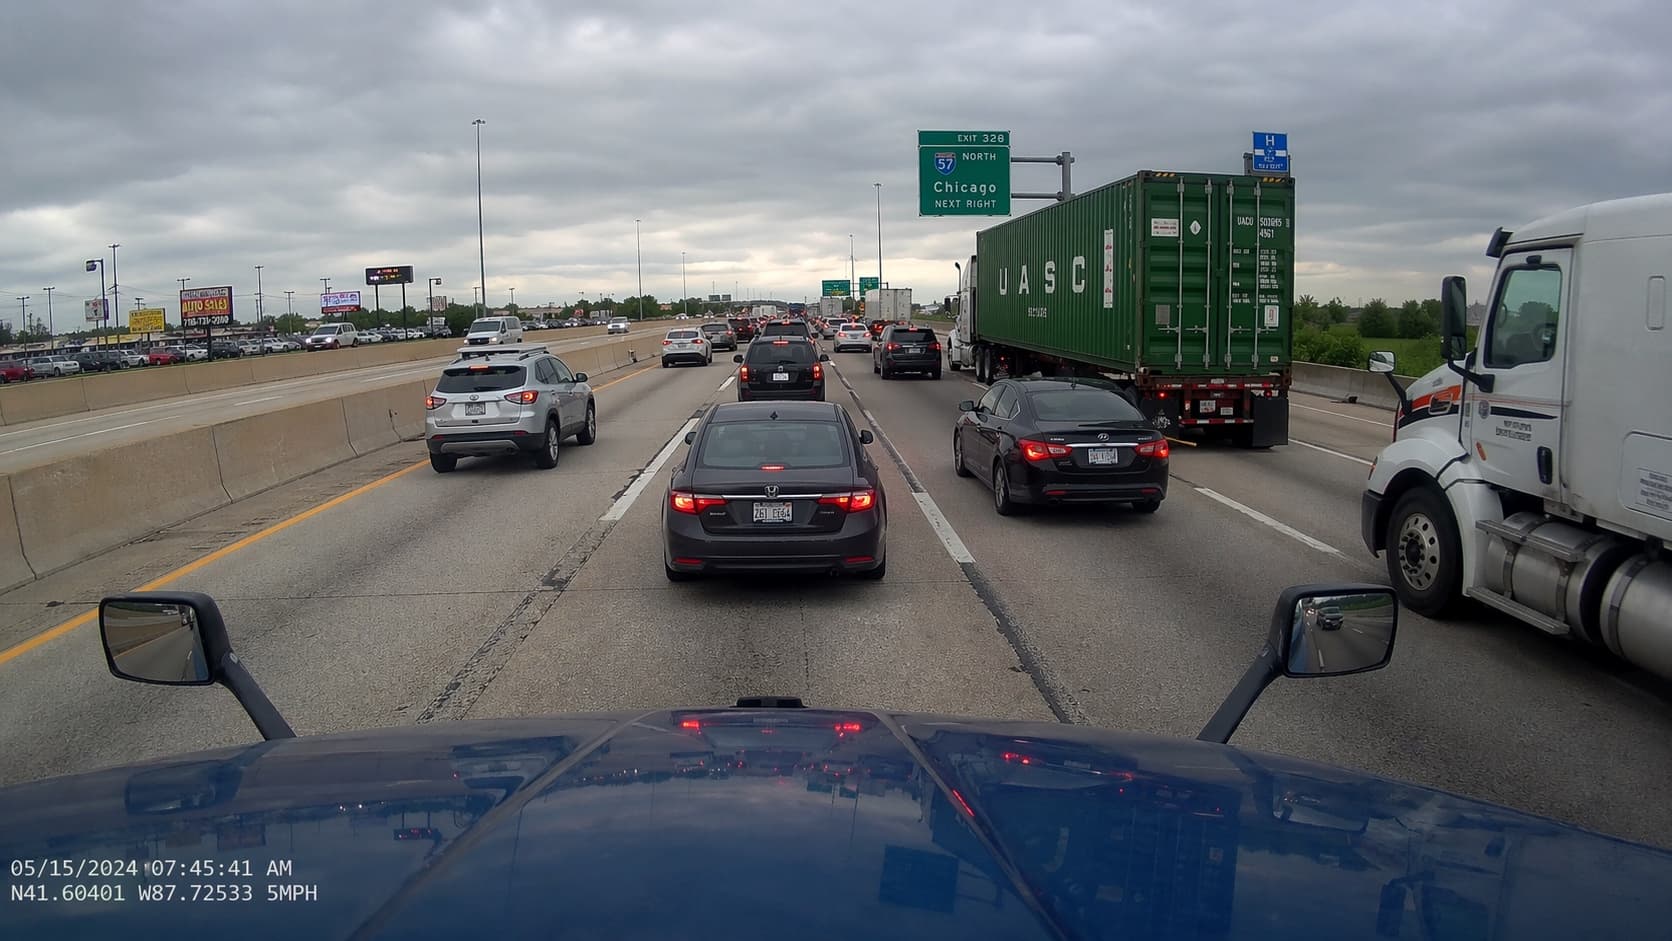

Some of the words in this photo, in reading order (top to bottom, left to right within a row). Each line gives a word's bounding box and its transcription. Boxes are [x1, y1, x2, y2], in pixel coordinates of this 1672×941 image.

[958, 134, 977, 143] EXIT
[1265, 135, 1275, 146] H
[962, 153, 996, 161] NORTH
[938, 158, 953, 170] 57
[934, 181, 997, 196] Chicago
[935, 200, 961, 208] NEXT
[966, 200, 997, 208] RIGHT
[1000, 255, 1085, 296] UASC
[182, 300, 204, 313] AUTO
